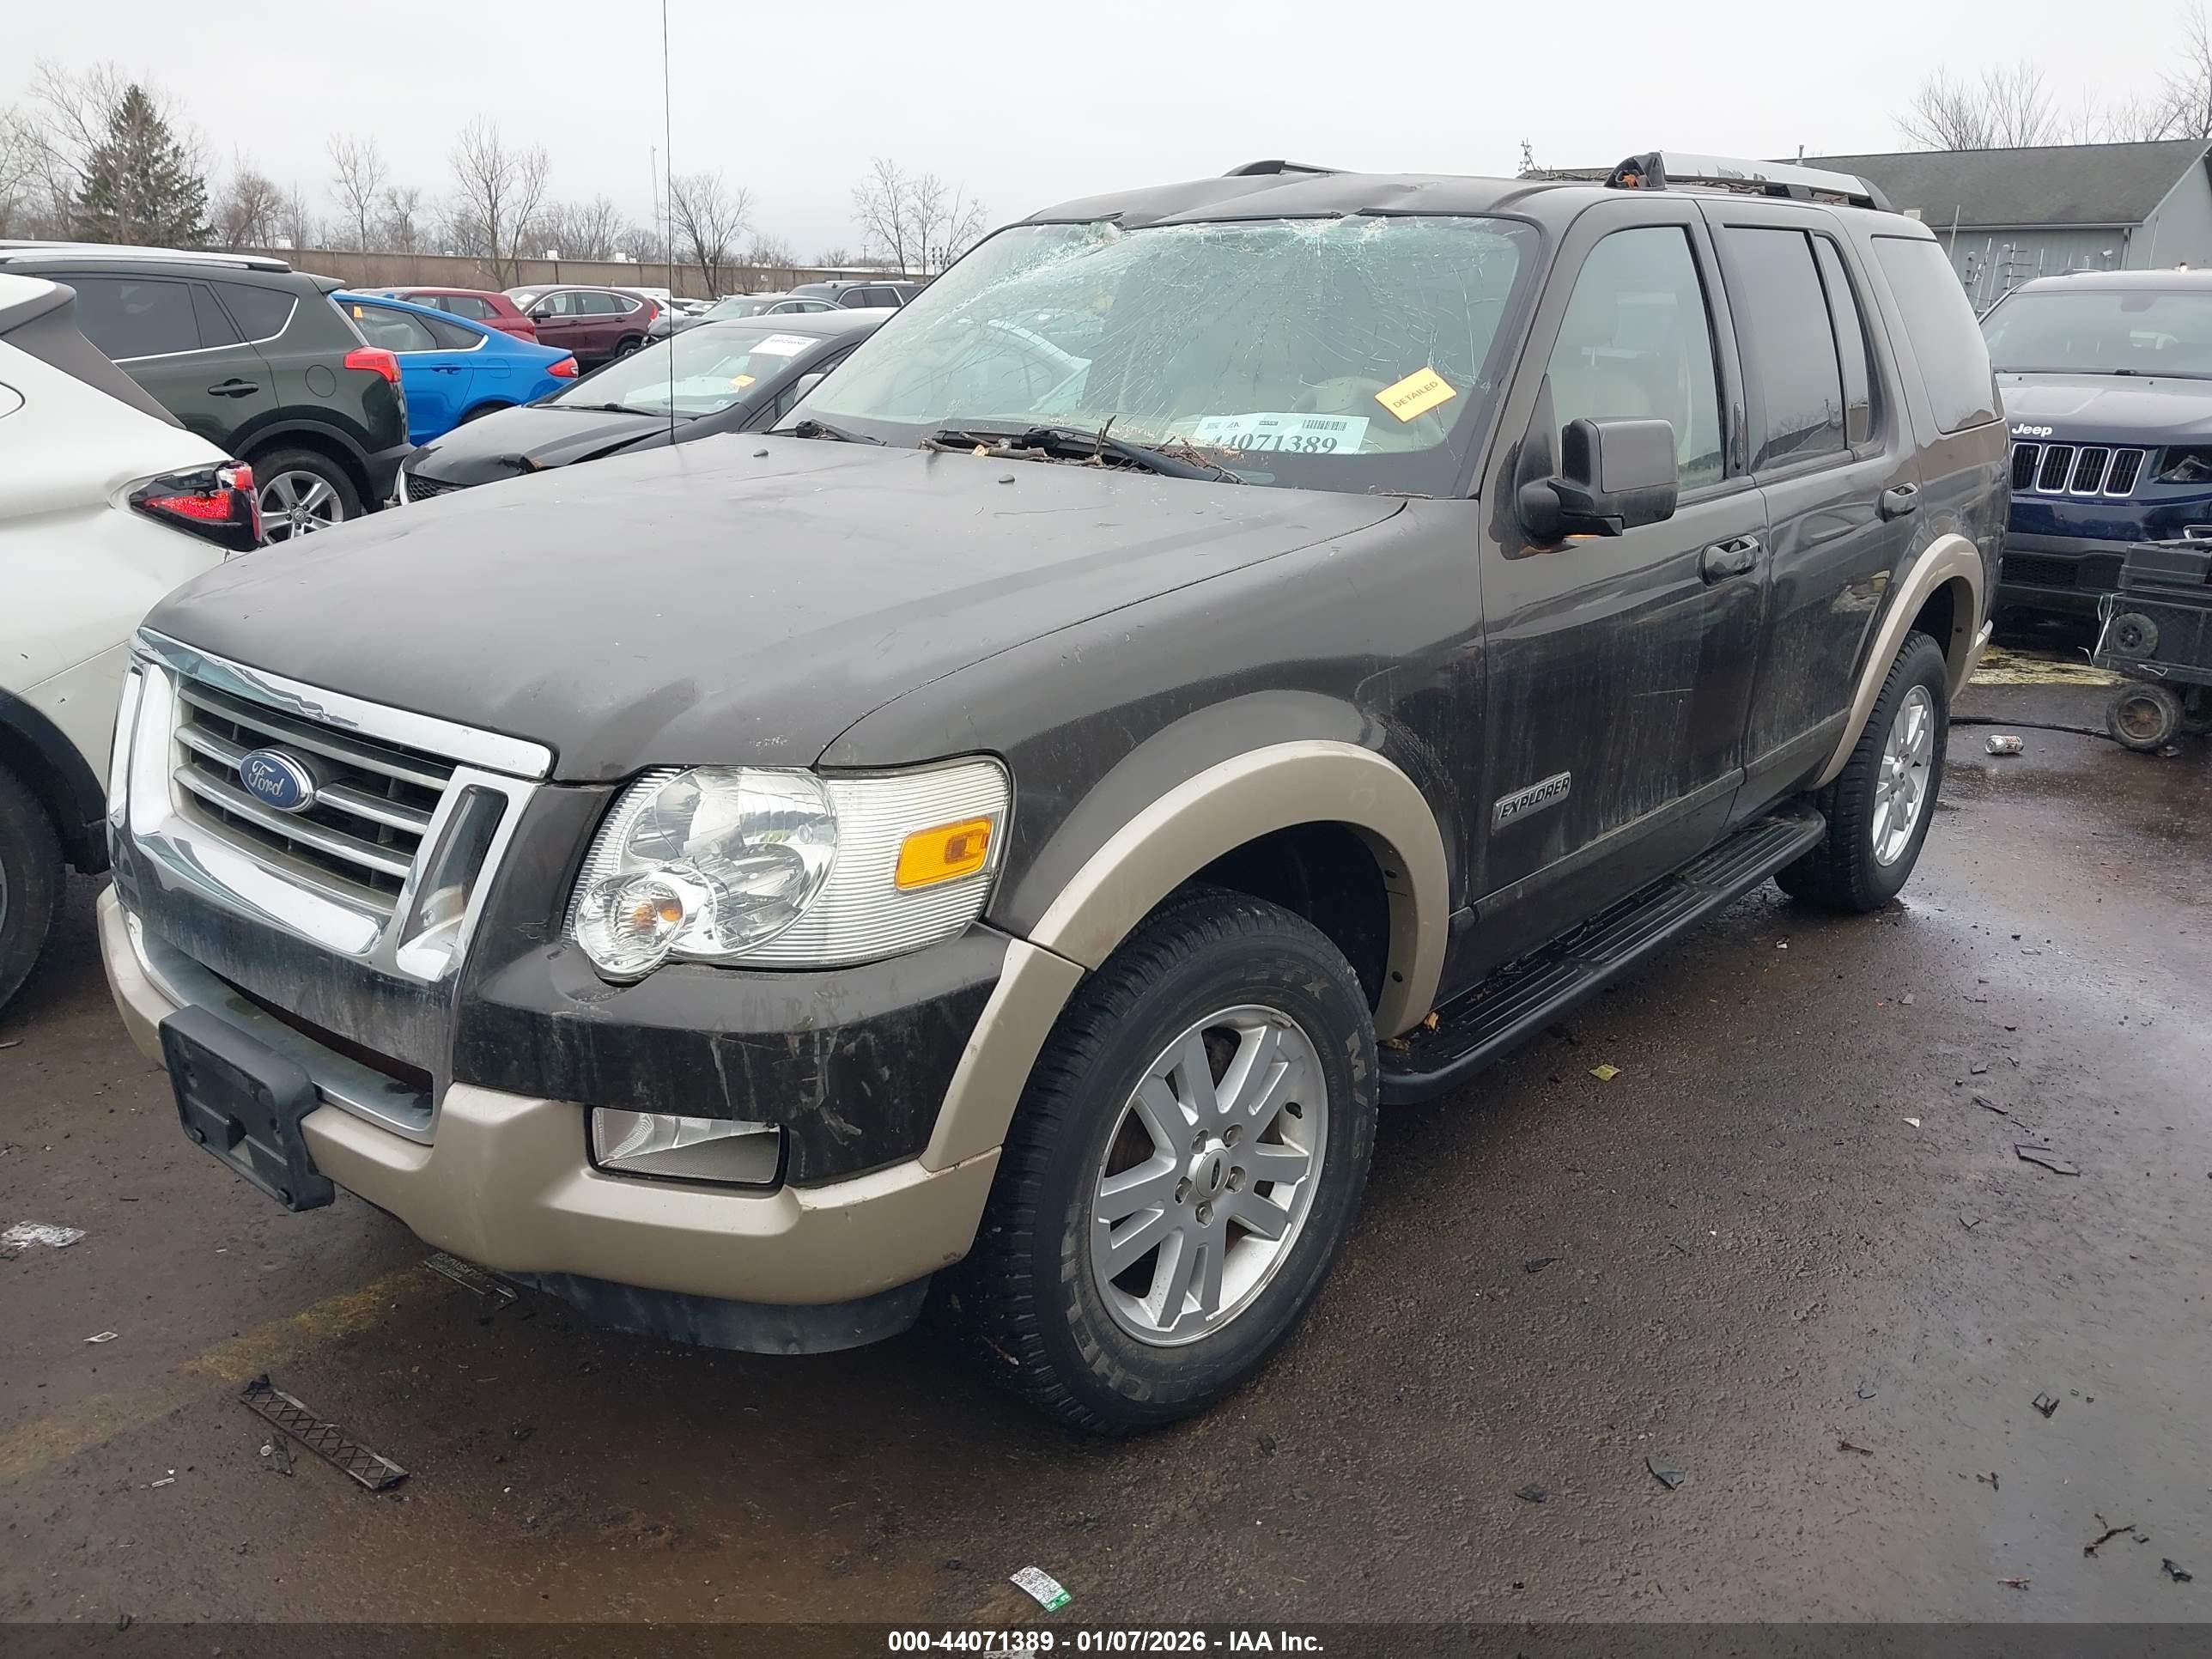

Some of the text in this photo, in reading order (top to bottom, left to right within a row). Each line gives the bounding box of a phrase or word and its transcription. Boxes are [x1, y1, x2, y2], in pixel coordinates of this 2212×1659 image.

[1392, 380, 1438, 409] DETAILED
[2011, 422, 2053, 438] Jeep
[247, 760, 286, 798] Ford
[1498, 775, 1571, 820] EXPLORER
